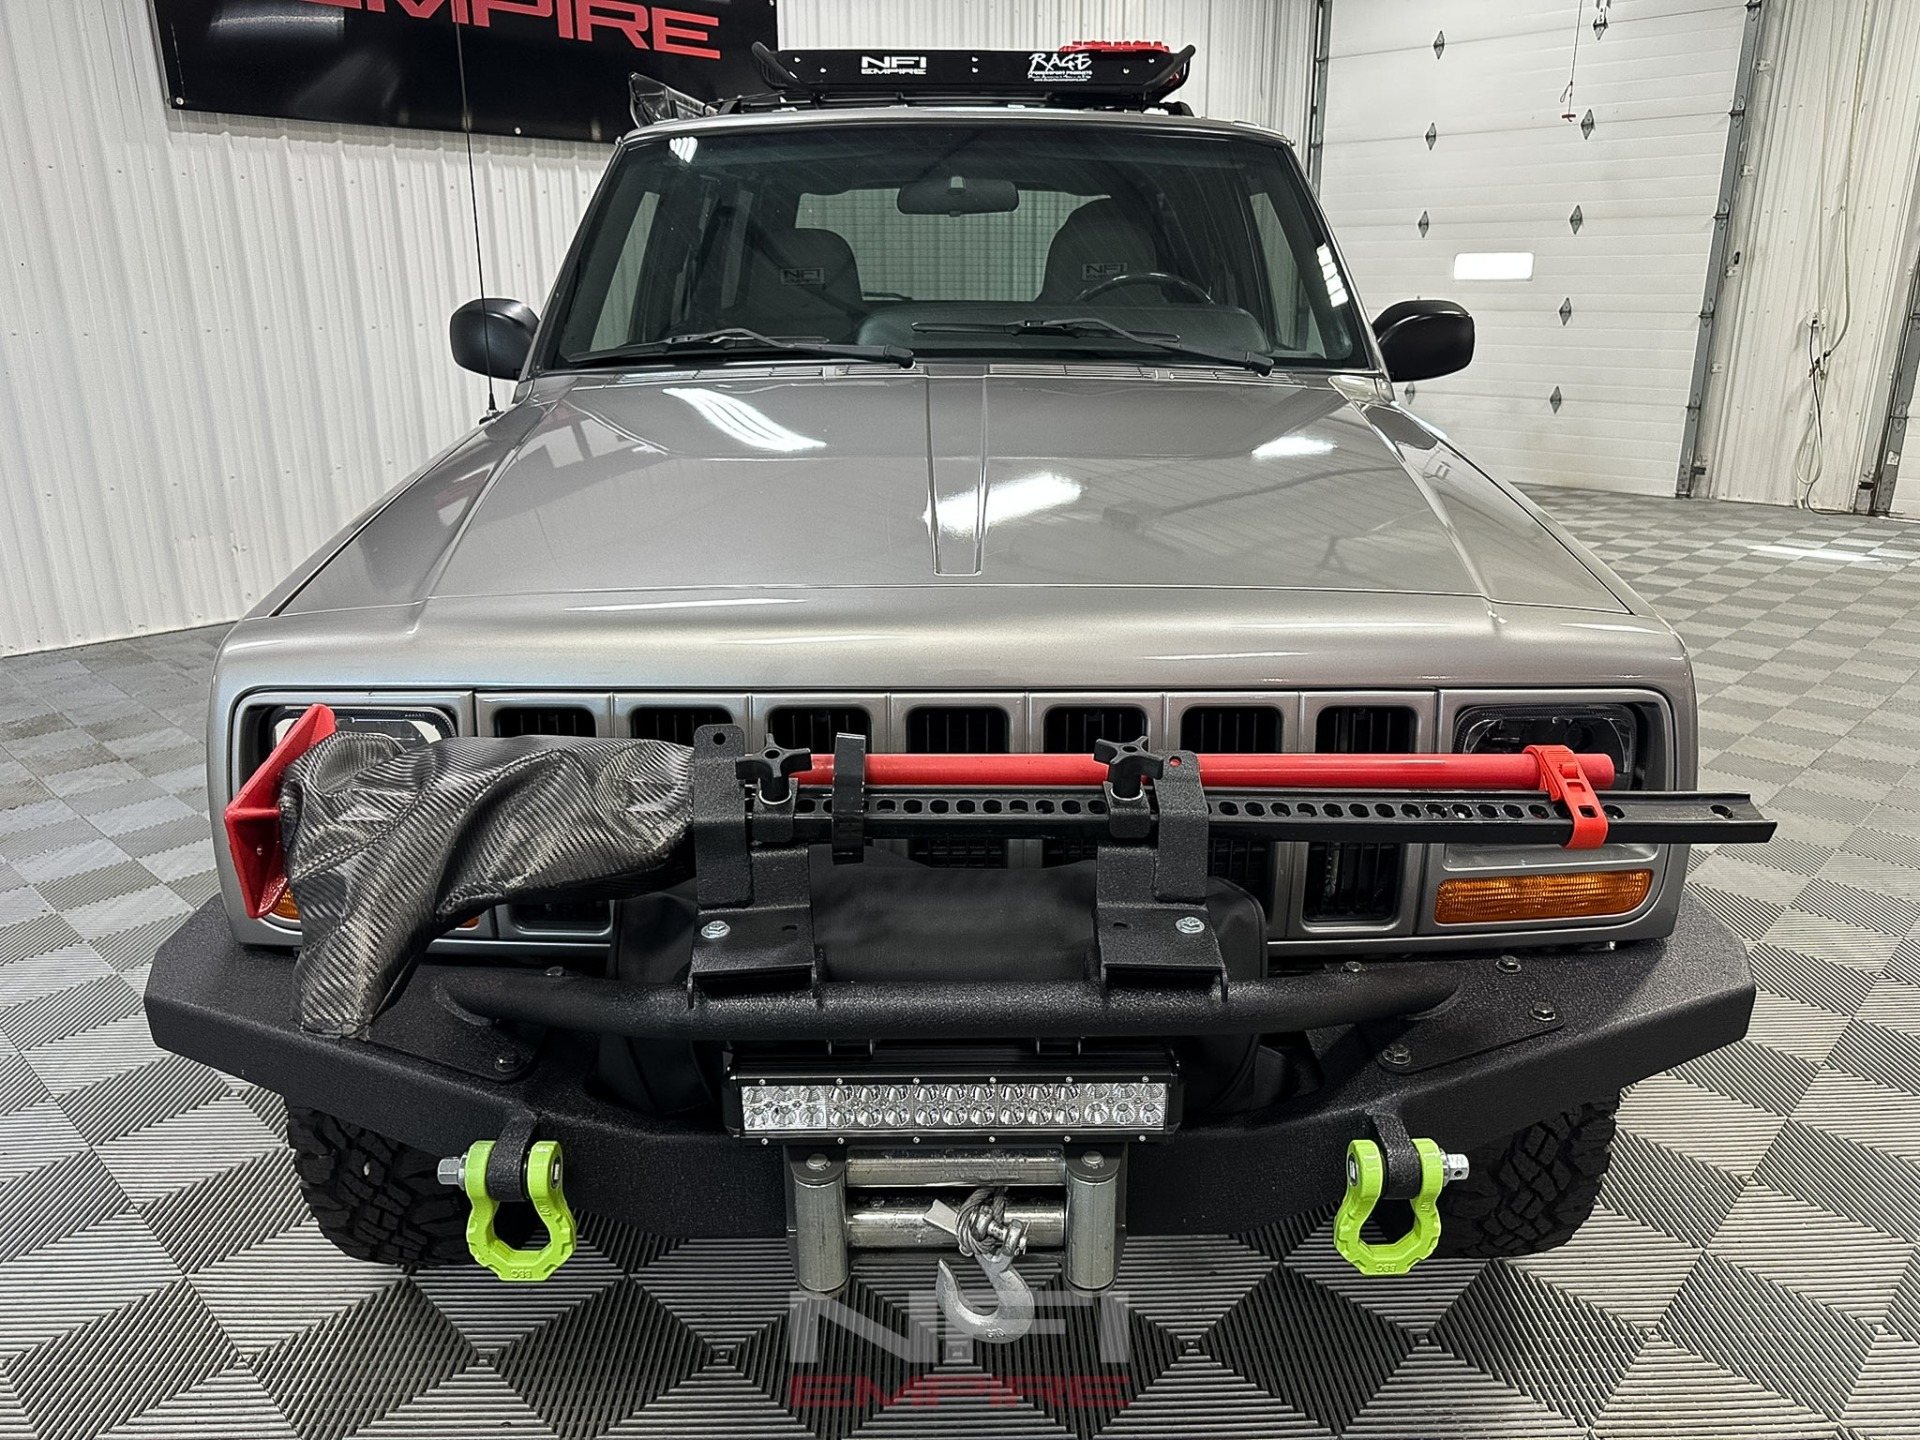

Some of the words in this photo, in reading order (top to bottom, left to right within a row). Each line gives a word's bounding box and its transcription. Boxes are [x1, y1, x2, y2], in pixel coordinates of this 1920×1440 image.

[298, 0, 720, 59] MPIRE
[861, 56, 927, 68] NFI
[1027, 53, 1092, 73] RAGE
[783, 269, 821, 278] NFI
